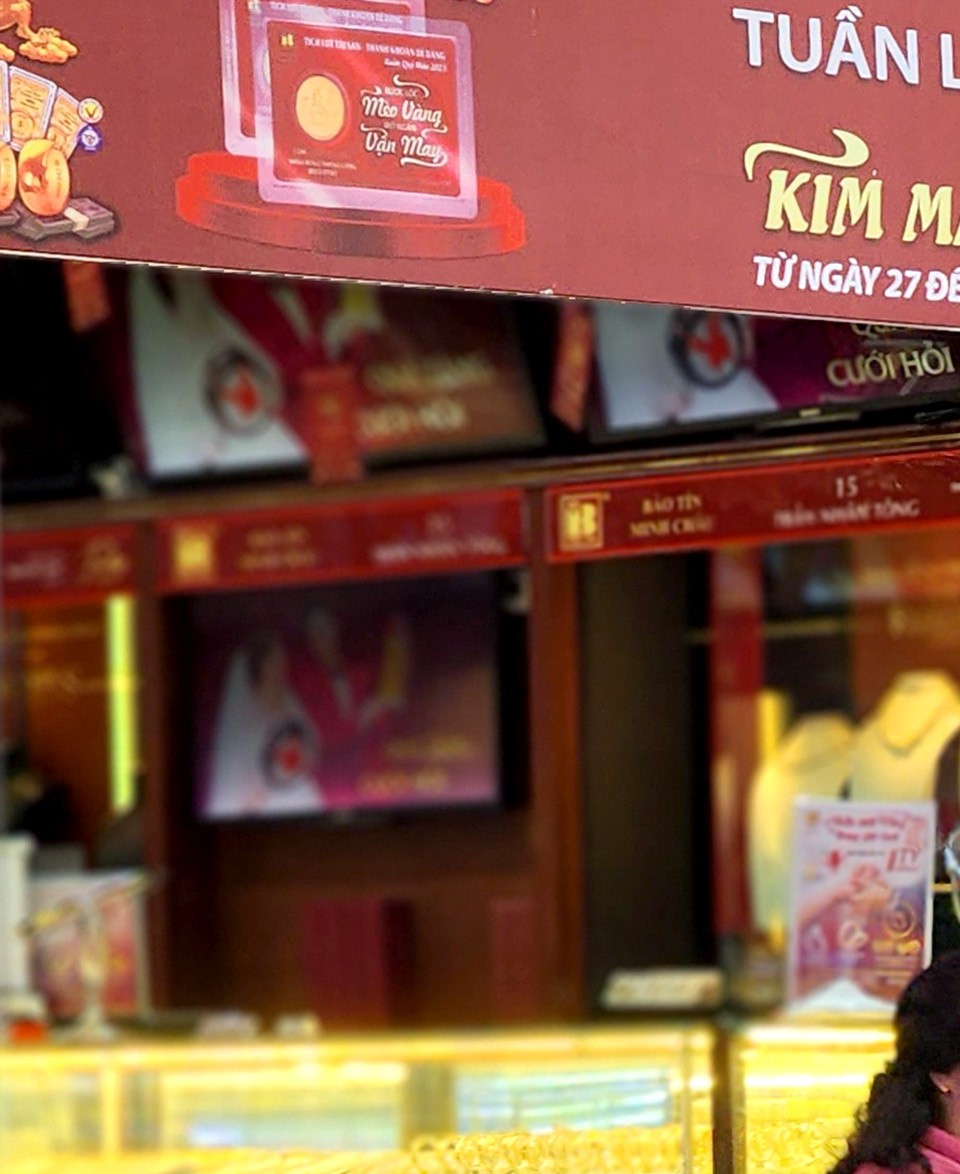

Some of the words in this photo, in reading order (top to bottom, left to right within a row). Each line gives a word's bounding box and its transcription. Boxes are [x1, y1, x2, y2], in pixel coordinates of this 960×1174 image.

[731, 5, 920, 85] TUẦN
[361, 96, 398, 118] Mèo
[402, 100, 443, 128] Vàng
[365, 131, 397, 157] Vận
[401, 135, 447, 166] May
[764, 168, 885, 240] KIM
[752, 255, 800, 288] TỪ
[799, 262, 882, 297] NGÀY
[885, 268, 920, 299] 27
[835, 474, 859, 499] 15
